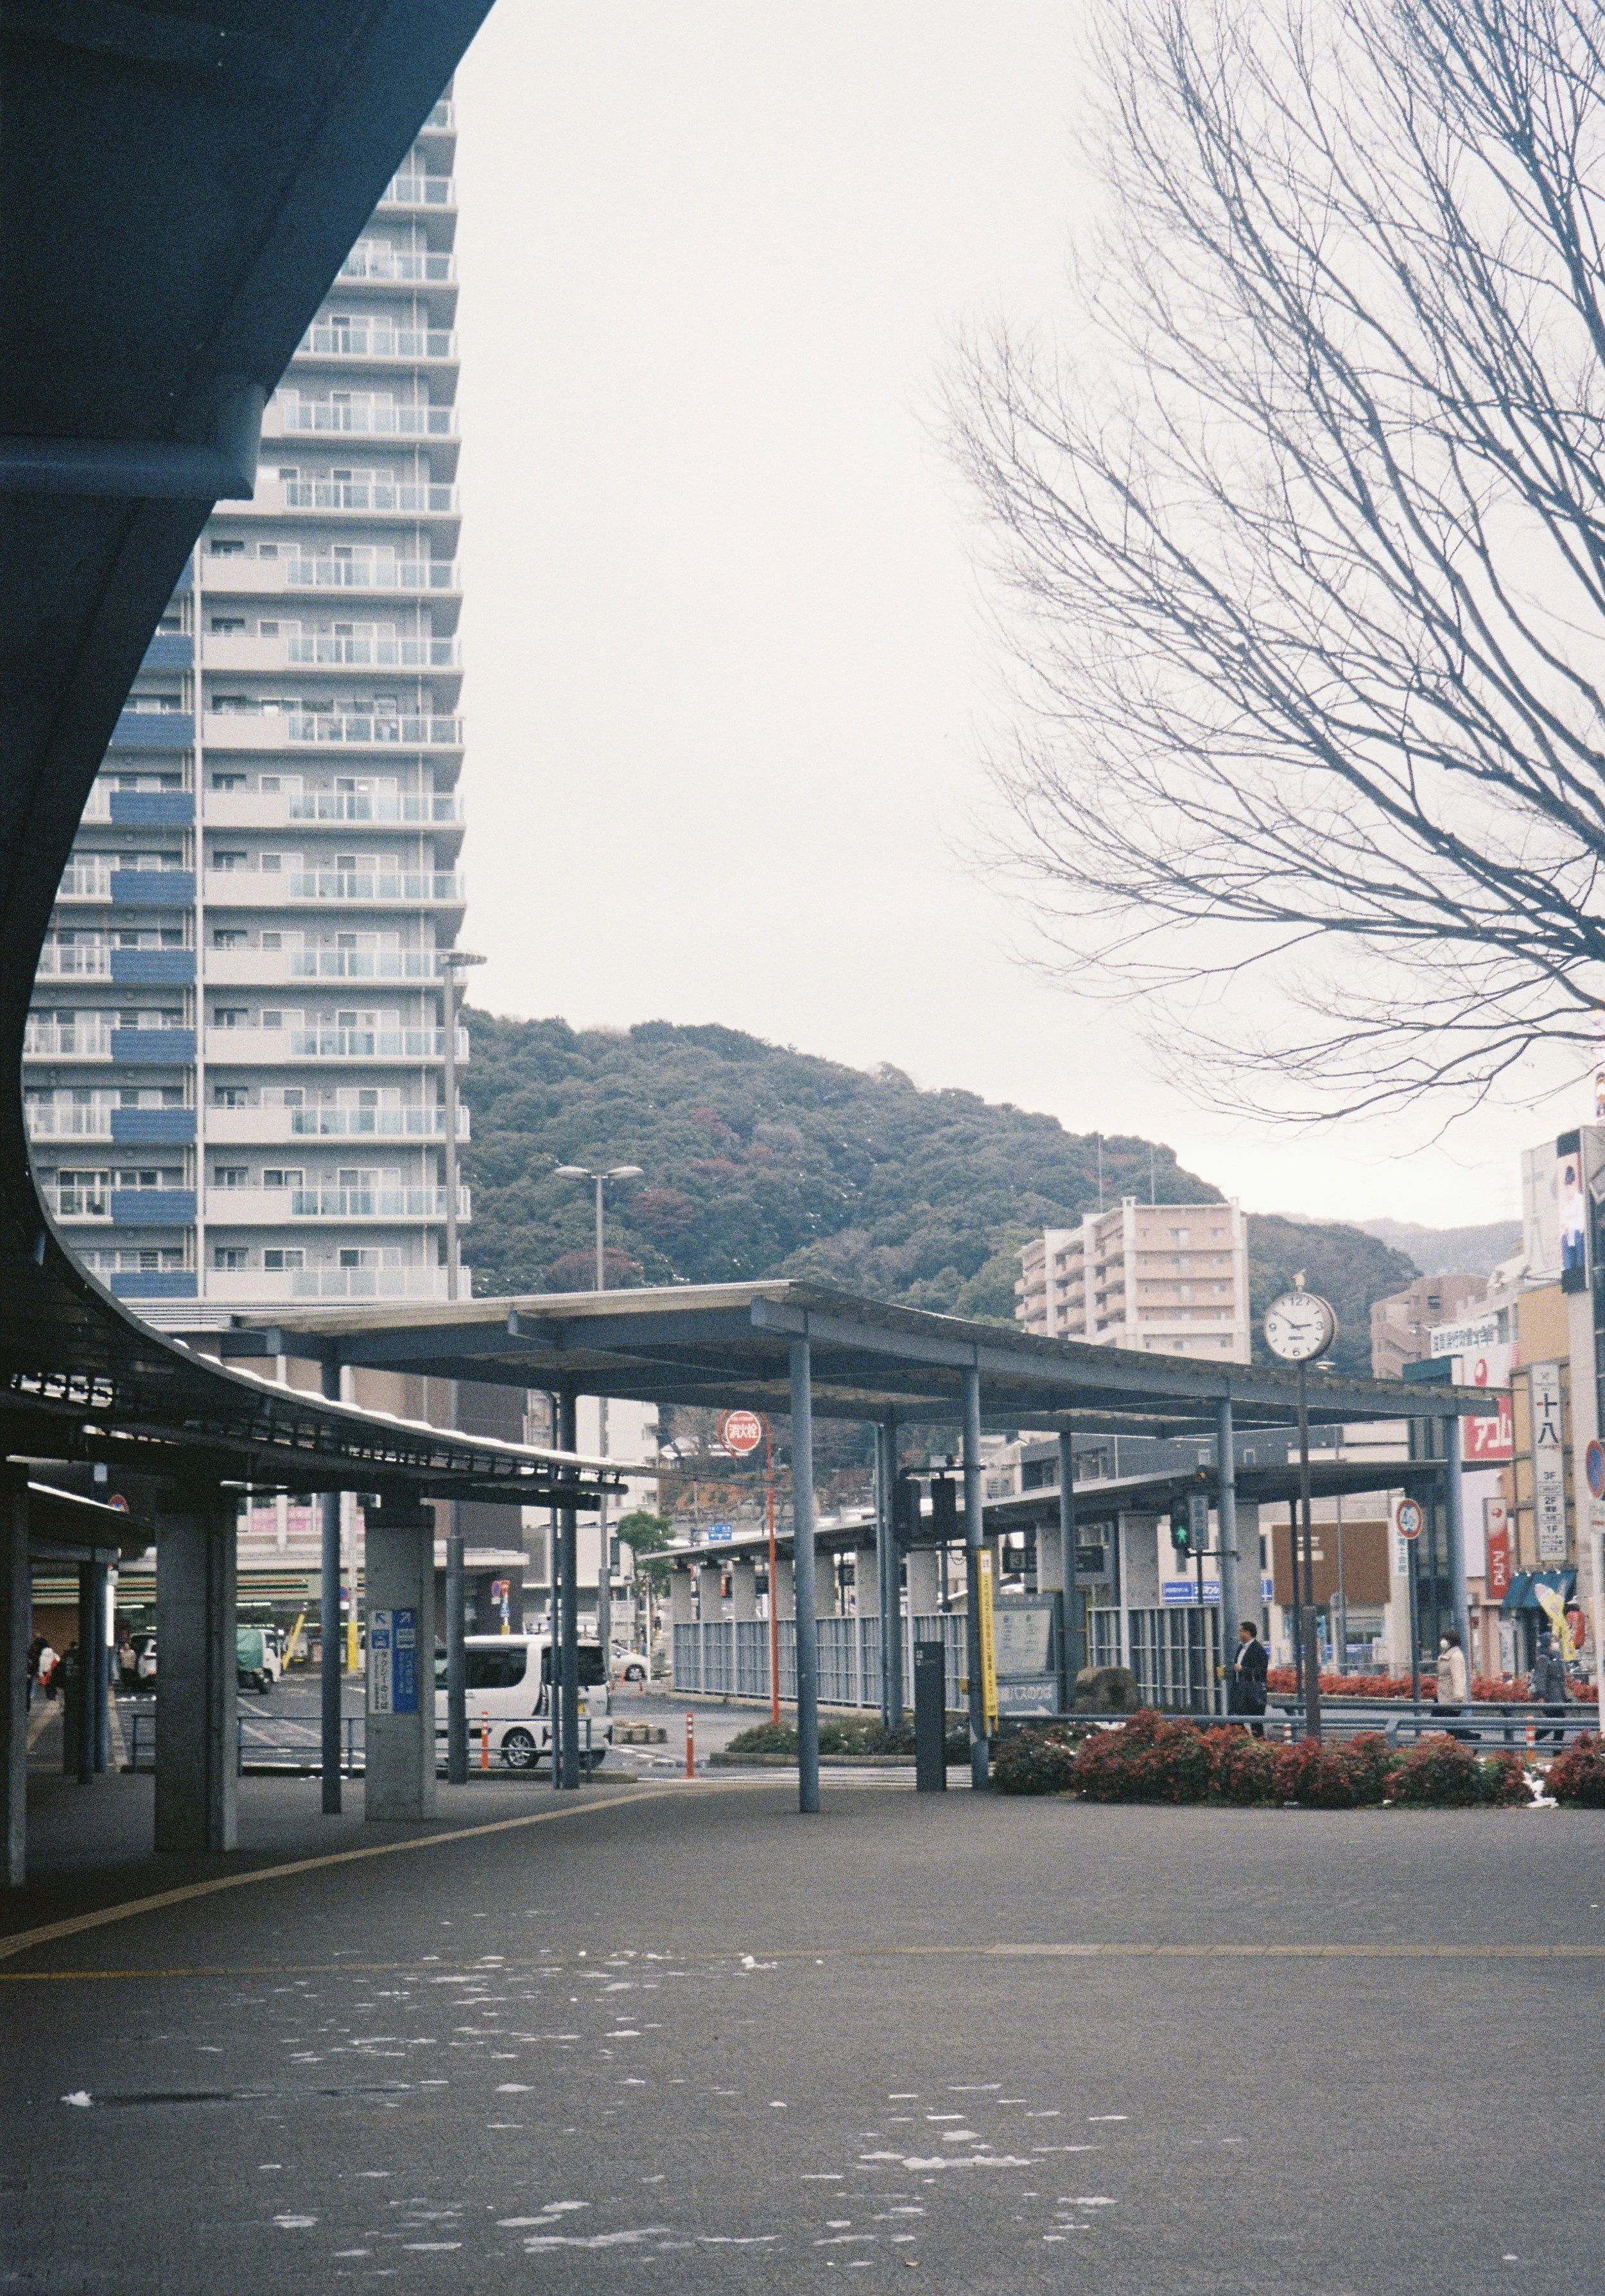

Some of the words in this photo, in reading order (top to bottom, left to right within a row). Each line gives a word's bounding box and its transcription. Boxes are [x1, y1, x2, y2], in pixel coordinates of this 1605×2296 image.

[1290, 1297, 1303, 1306] 12
[1269, 1322, 1277, 1332] 9
[1315, 1320, 1323, 1330] 3
[1292, 1347, 1300, 1356] 6
[1536, 1393, 1559, 1444] 十八
[729, 1423, 758, 1438] 消火栓
[1473, 1413, 1512, 1452] アコム
[1543, 1471, 1556, 1480] 3F
[1545, 1496, 1556, 1505] 2F
[1546, 1525, 1557, 1533] 1F
[1013, 1554, 1022, 1566] 3
[1493, 1550, 1507, 1586] アコム
